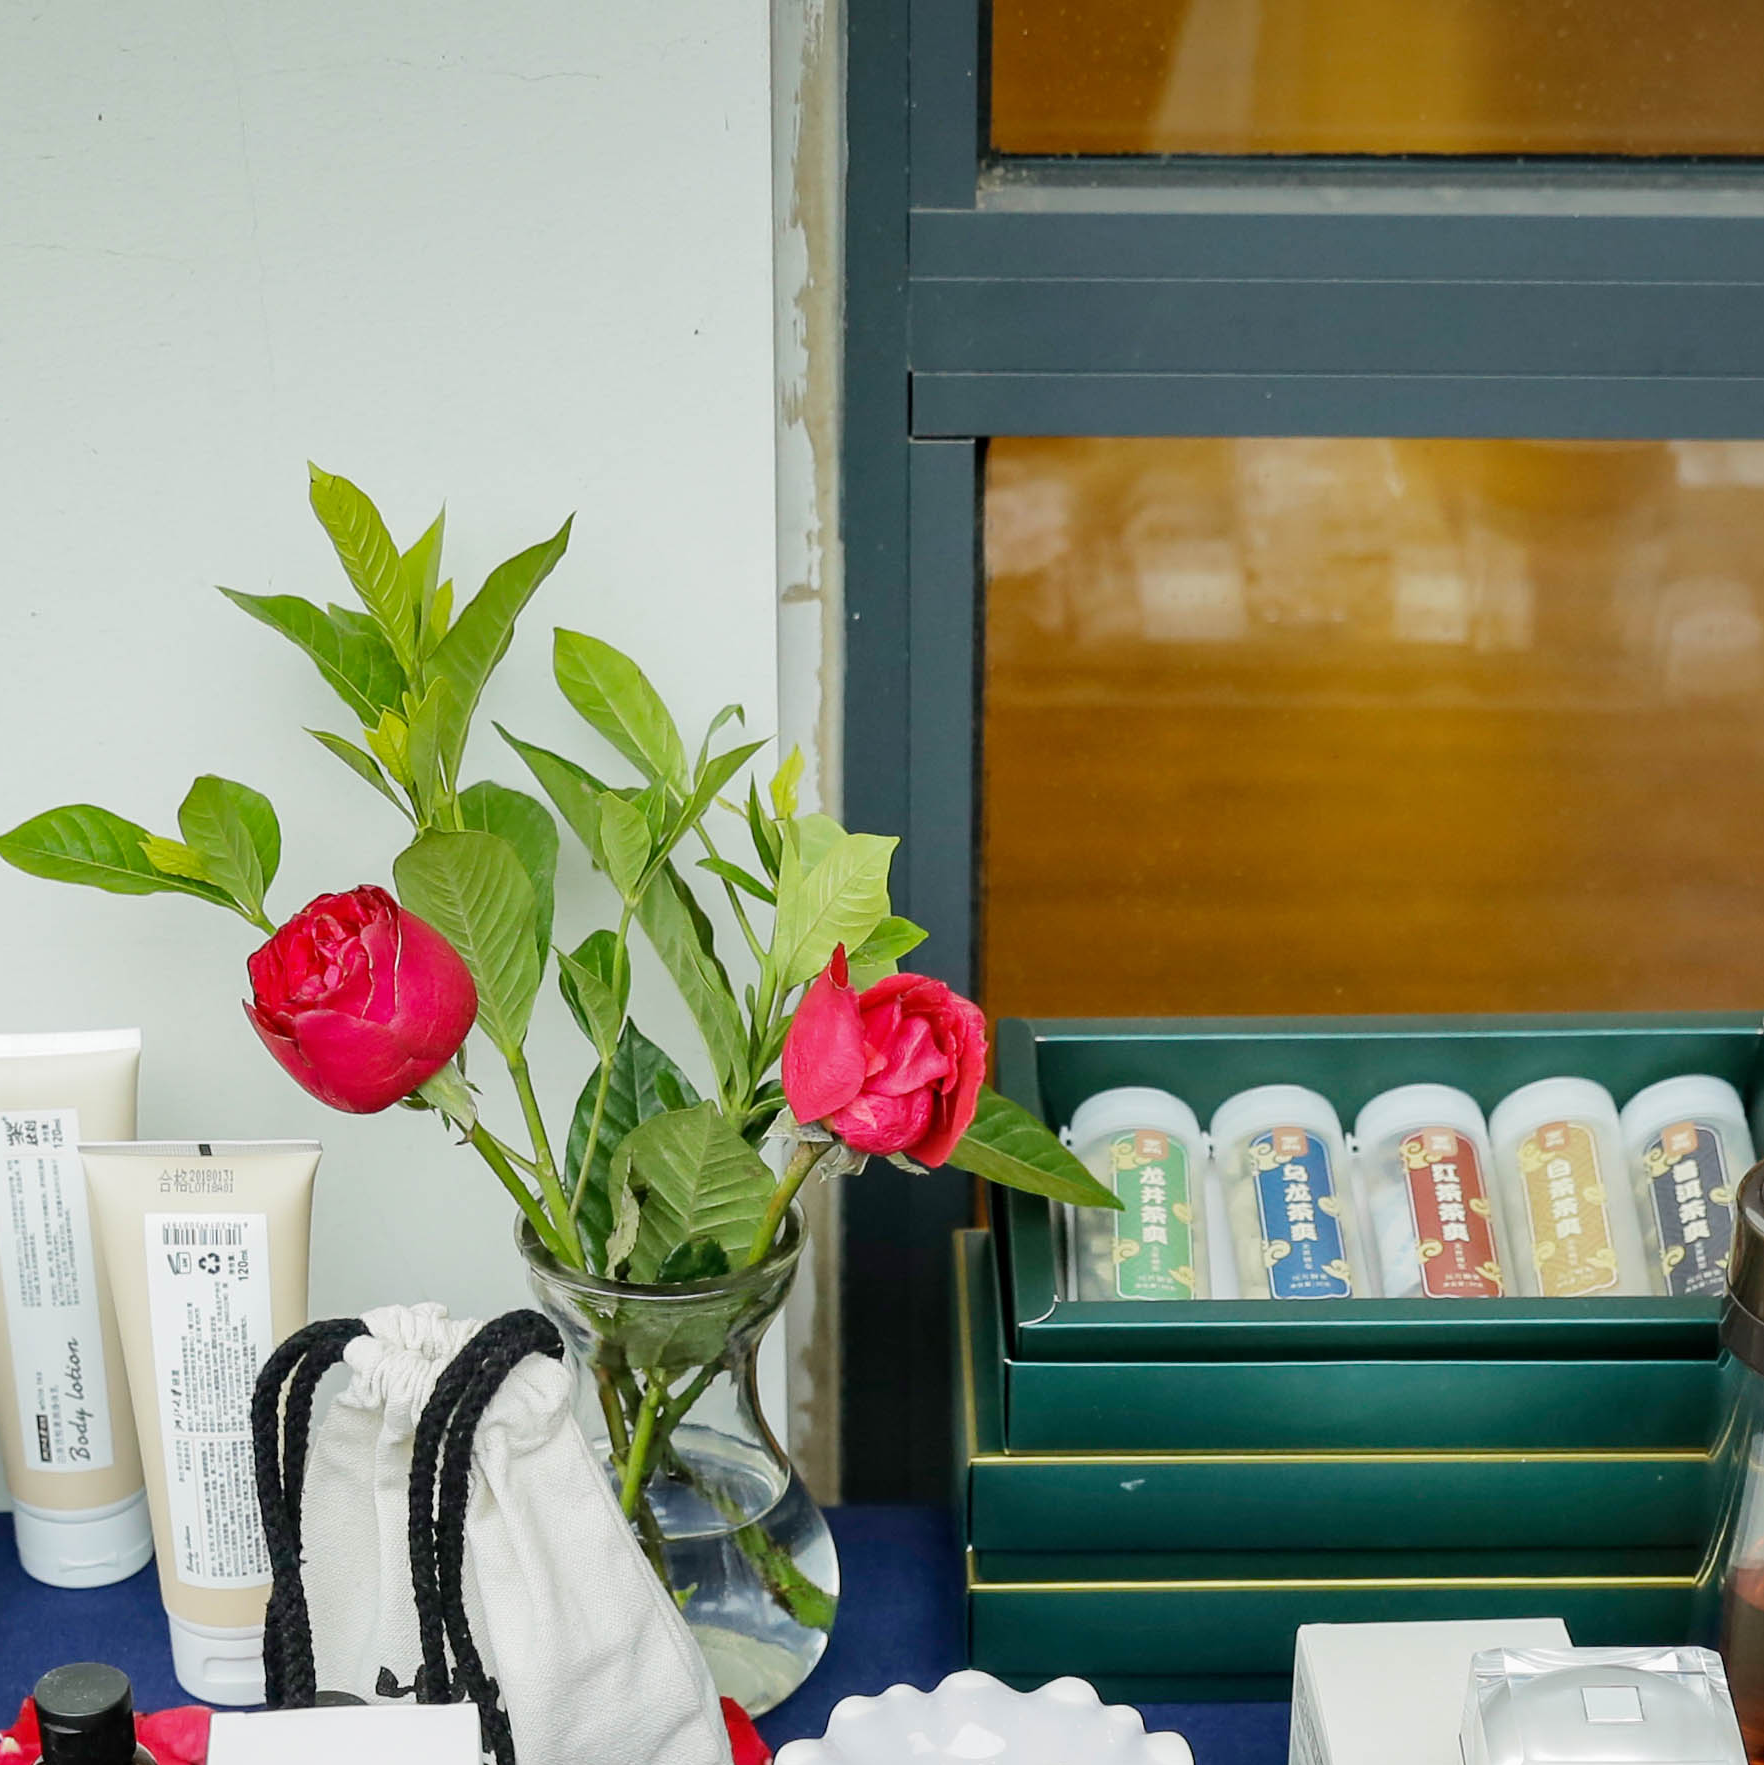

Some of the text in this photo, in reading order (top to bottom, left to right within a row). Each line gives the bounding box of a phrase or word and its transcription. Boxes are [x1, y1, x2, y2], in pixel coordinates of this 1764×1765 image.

[1139, 1166, 1168, 1245] 龙井茶爽
[1283, 1164, 1318, 1242] 乌龙茶爽
[1431, 1163, 1470, 1242] 红茶茶爽
[68, 1408, 93, 1461] Body
